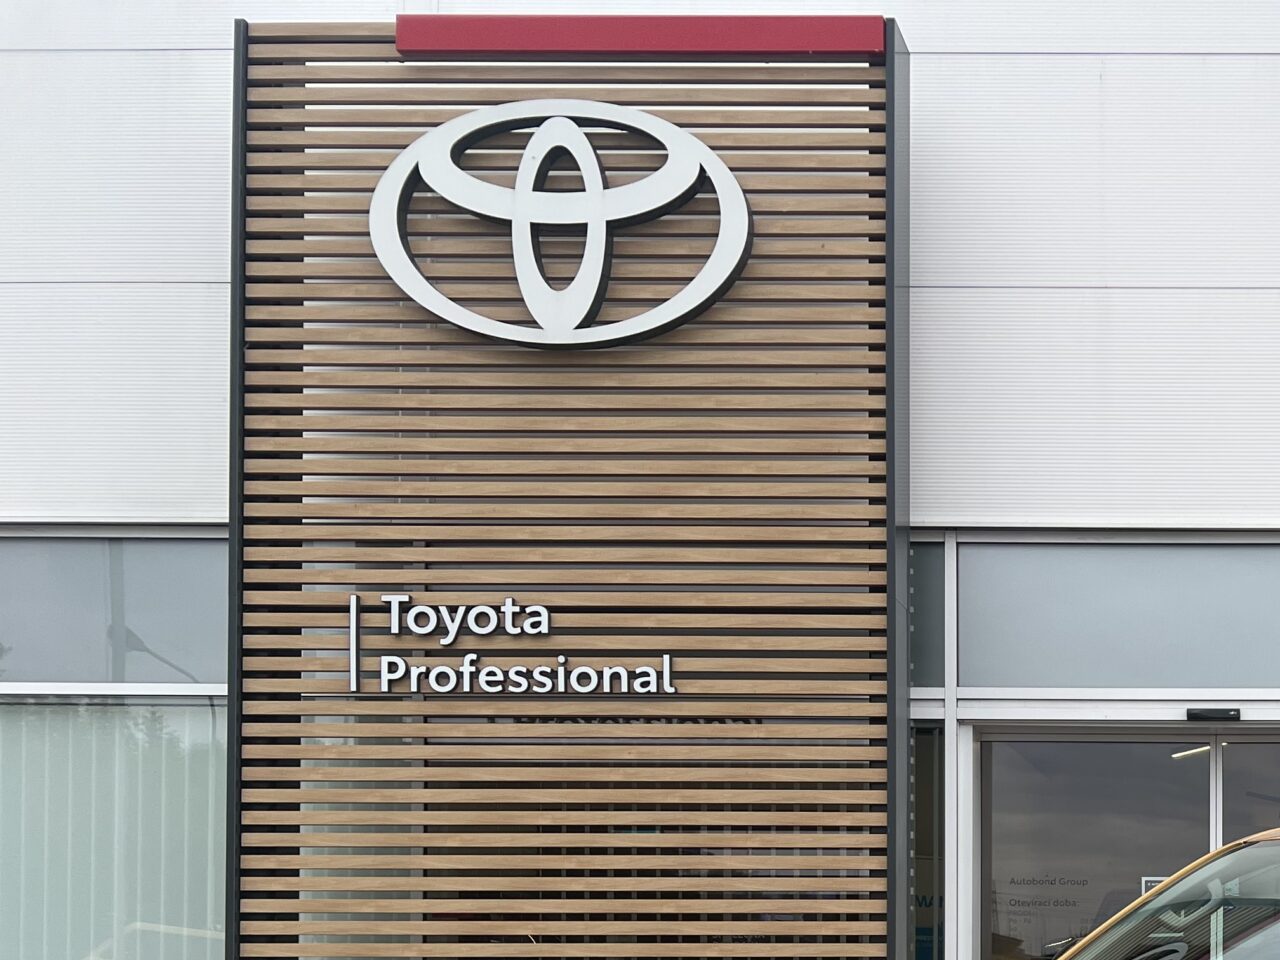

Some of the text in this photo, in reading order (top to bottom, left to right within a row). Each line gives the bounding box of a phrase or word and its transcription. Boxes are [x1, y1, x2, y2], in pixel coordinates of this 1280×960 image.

[380, 594, 550, 646] Toyota
[380, 653, 676, 694] Professional
[1009, 877, 1089, 887] Autobond Group
